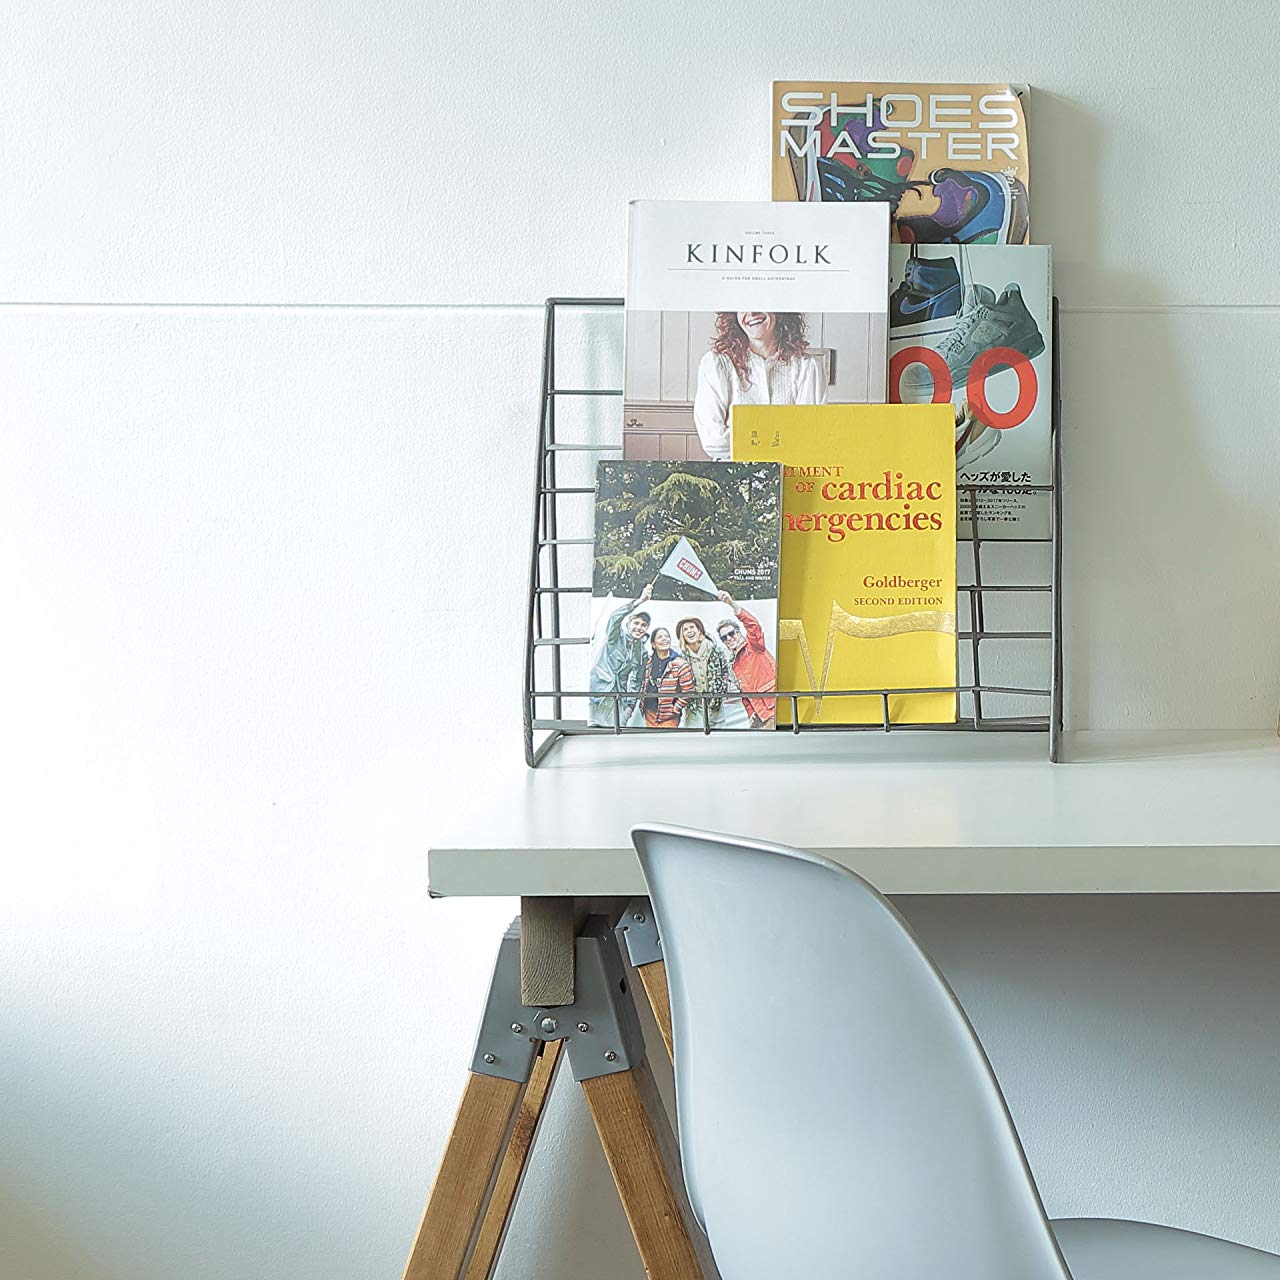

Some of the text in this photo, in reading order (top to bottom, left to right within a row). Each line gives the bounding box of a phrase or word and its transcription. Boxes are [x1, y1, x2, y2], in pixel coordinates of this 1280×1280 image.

[780, 92, 1018, 129] SHOES
[779, 130, 1019, 161] MASTER
[686, 243, 832, 264] KINFOLK
[795, 470, 942, 501] OF cardiac
[960, 471, 1032, 483] ヘッズが愛した
[679, 559, 703, 579] CHUMS
[863, 575, 943, 591] Goldberger
[854, 597, 943, 606] SECOND EDITION
